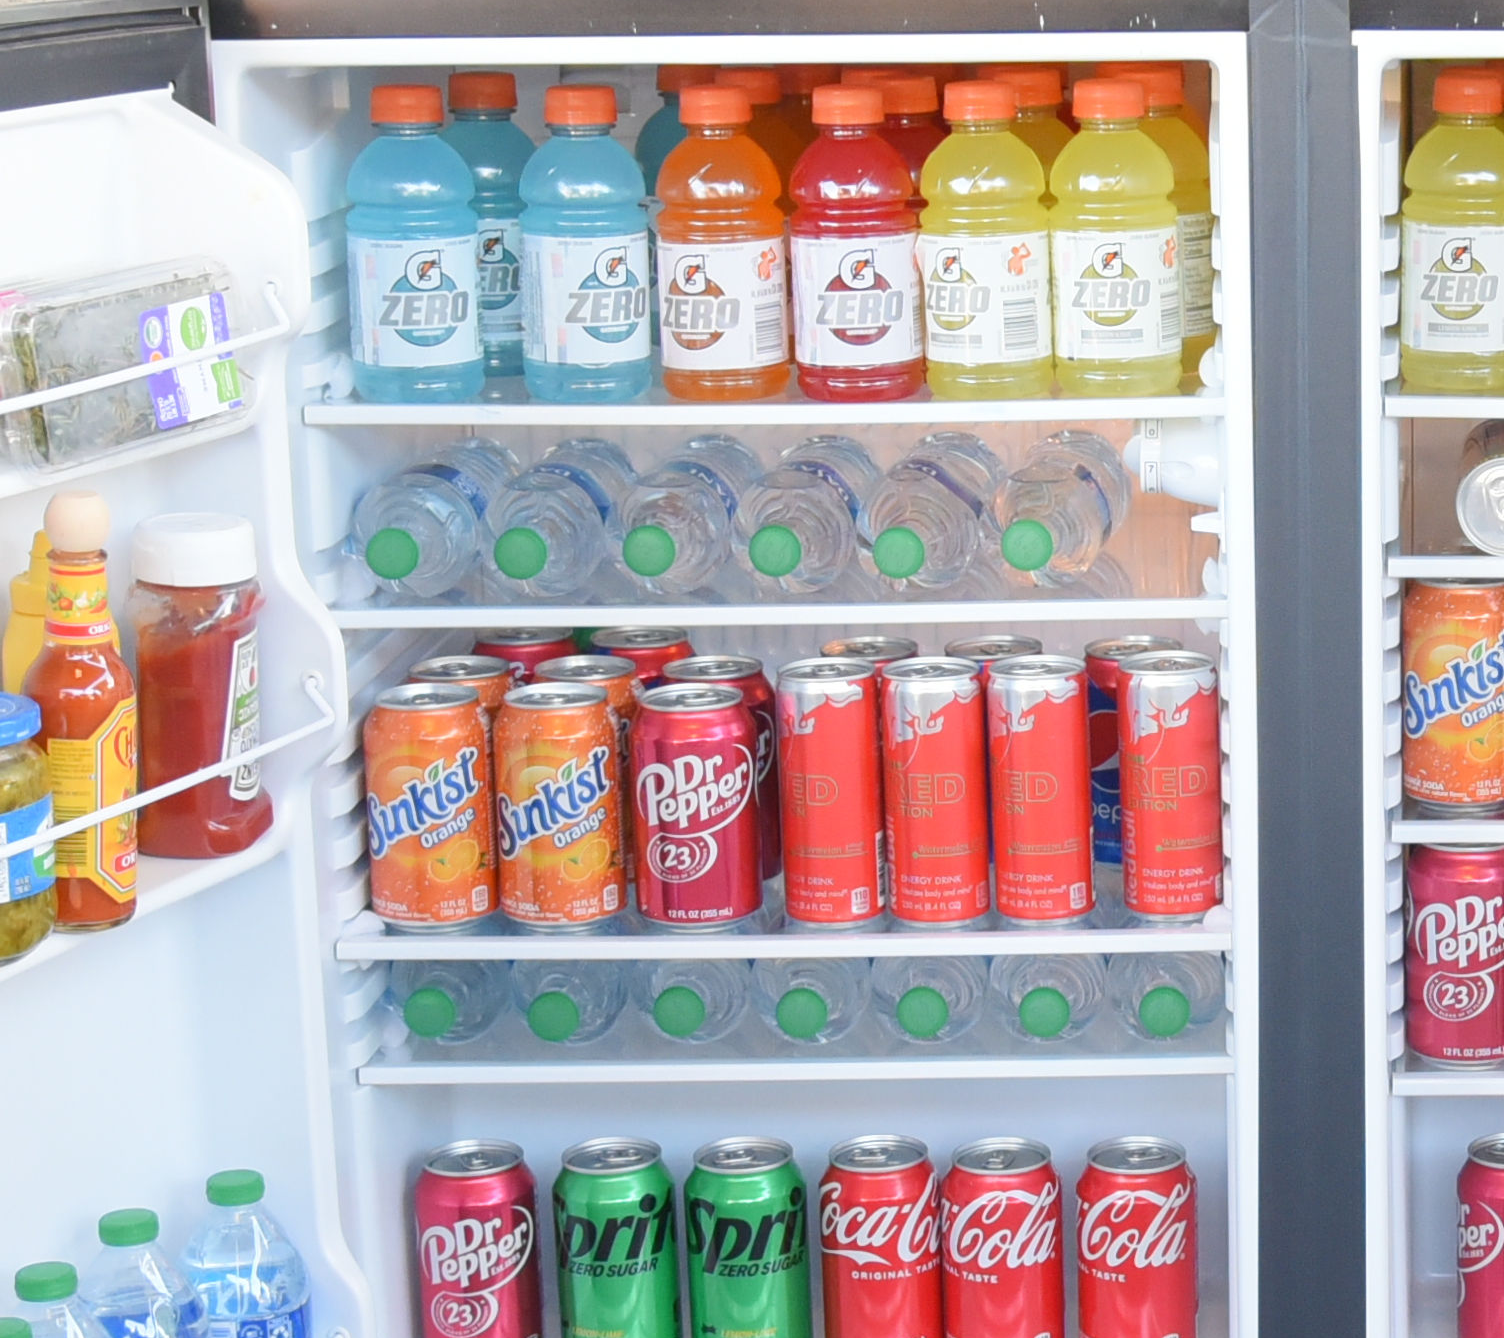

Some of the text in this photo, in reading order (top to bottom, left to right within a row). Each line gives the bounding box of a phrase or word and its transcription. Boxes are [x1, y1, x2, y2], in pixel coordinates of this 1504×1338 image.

[926, 283, 991, 314] ZERO
[1072, 279, 1151, 309] ZERO
[1420, 273, 1499, 303] ZERO
[379, 291, 469, 327] ZERO
[565, 287, 648, 324] ZERO
[662, 296, 740, 330] ZERO
[816, 290, 903, 327] ZERO
[673, 755, 723, 795] Dr
[368, 746, 478, 859] Sunkist
[498, 746, 610, 859] Sunkist
[637, 761, 748, 829] Pepper
[420, 807, 476, 849] Orange
[554, 807, 608, 849] Orange
[663, 844, 692, 870] 23
[1124, 810, 1139, 905] Red Bull
[1179, 866, 1204, 877] DRINK
[808, 877, 835, 886] DRINK
[901, 875, 962, 886] ENERGY DRINK
[1027, 874, 1054, 883] DRINK
[854, 890, 868, 901] 110
[668, 909, 700, 919] 12 FL OZ
[1455, 895, 1504, 935] Dr
[1441, 983, 1470, 1008] 23
[1443, 1047, 1474, 1056] 12 FL OZ
[453, 1218, 503, 1254] Dr
[689, 1187, 808, 1274] Spri
[421, 1221, 528, 1288] Pepper
[568, 1258, 660, 1278] ZERO SUGAR
[718, 1263, 760, 1277] ZERO
[851, 1269, 912, 1281] ORIGINAL
[962, 1271, 999, 1284] TASTE
[1091, 1269, 1126, 1283] TASTE
[447, 1301, 474, 1327] 23
